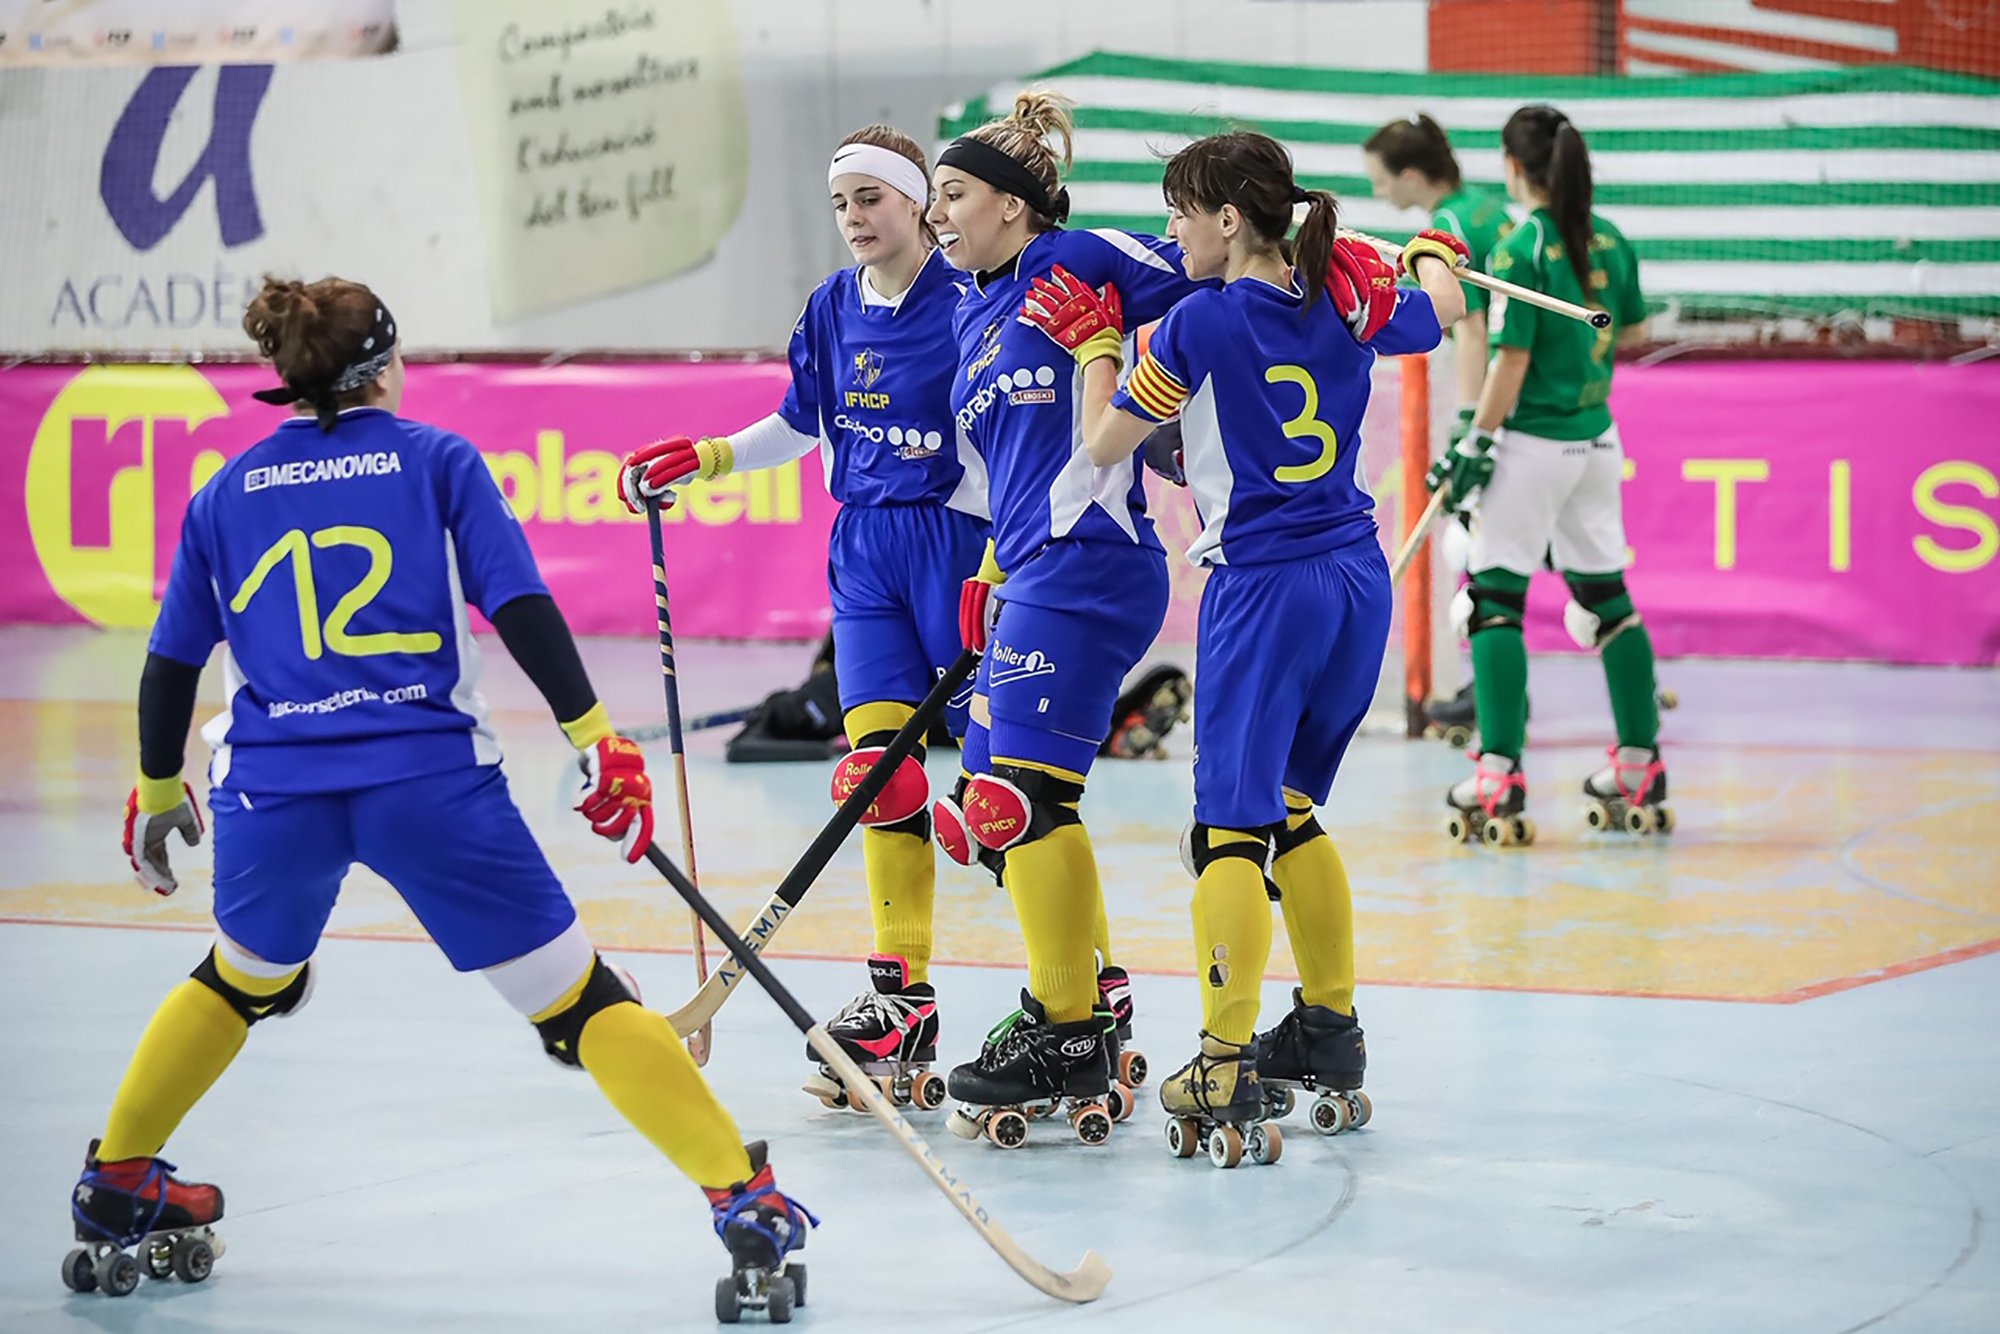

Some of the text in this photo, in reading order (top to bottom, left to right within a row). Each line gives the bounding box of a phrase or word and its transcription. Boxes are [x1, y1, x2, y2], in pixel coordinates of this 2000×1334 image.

[50, 259, 258, 330] ACADÈ
[844, 391, 890, 409] IFHCP
[1265, 365, 1337, 482] 3
[270, 452, 401, 486] MECANOVIGA
[480, 430, 802, 525] plaell
[1622, 458, 1999, 573] TIS
[229, 525, 443, 660] 12
[845, 762, 873, 776] Rolle
[980, 817, 1017, 835] IFHCP
